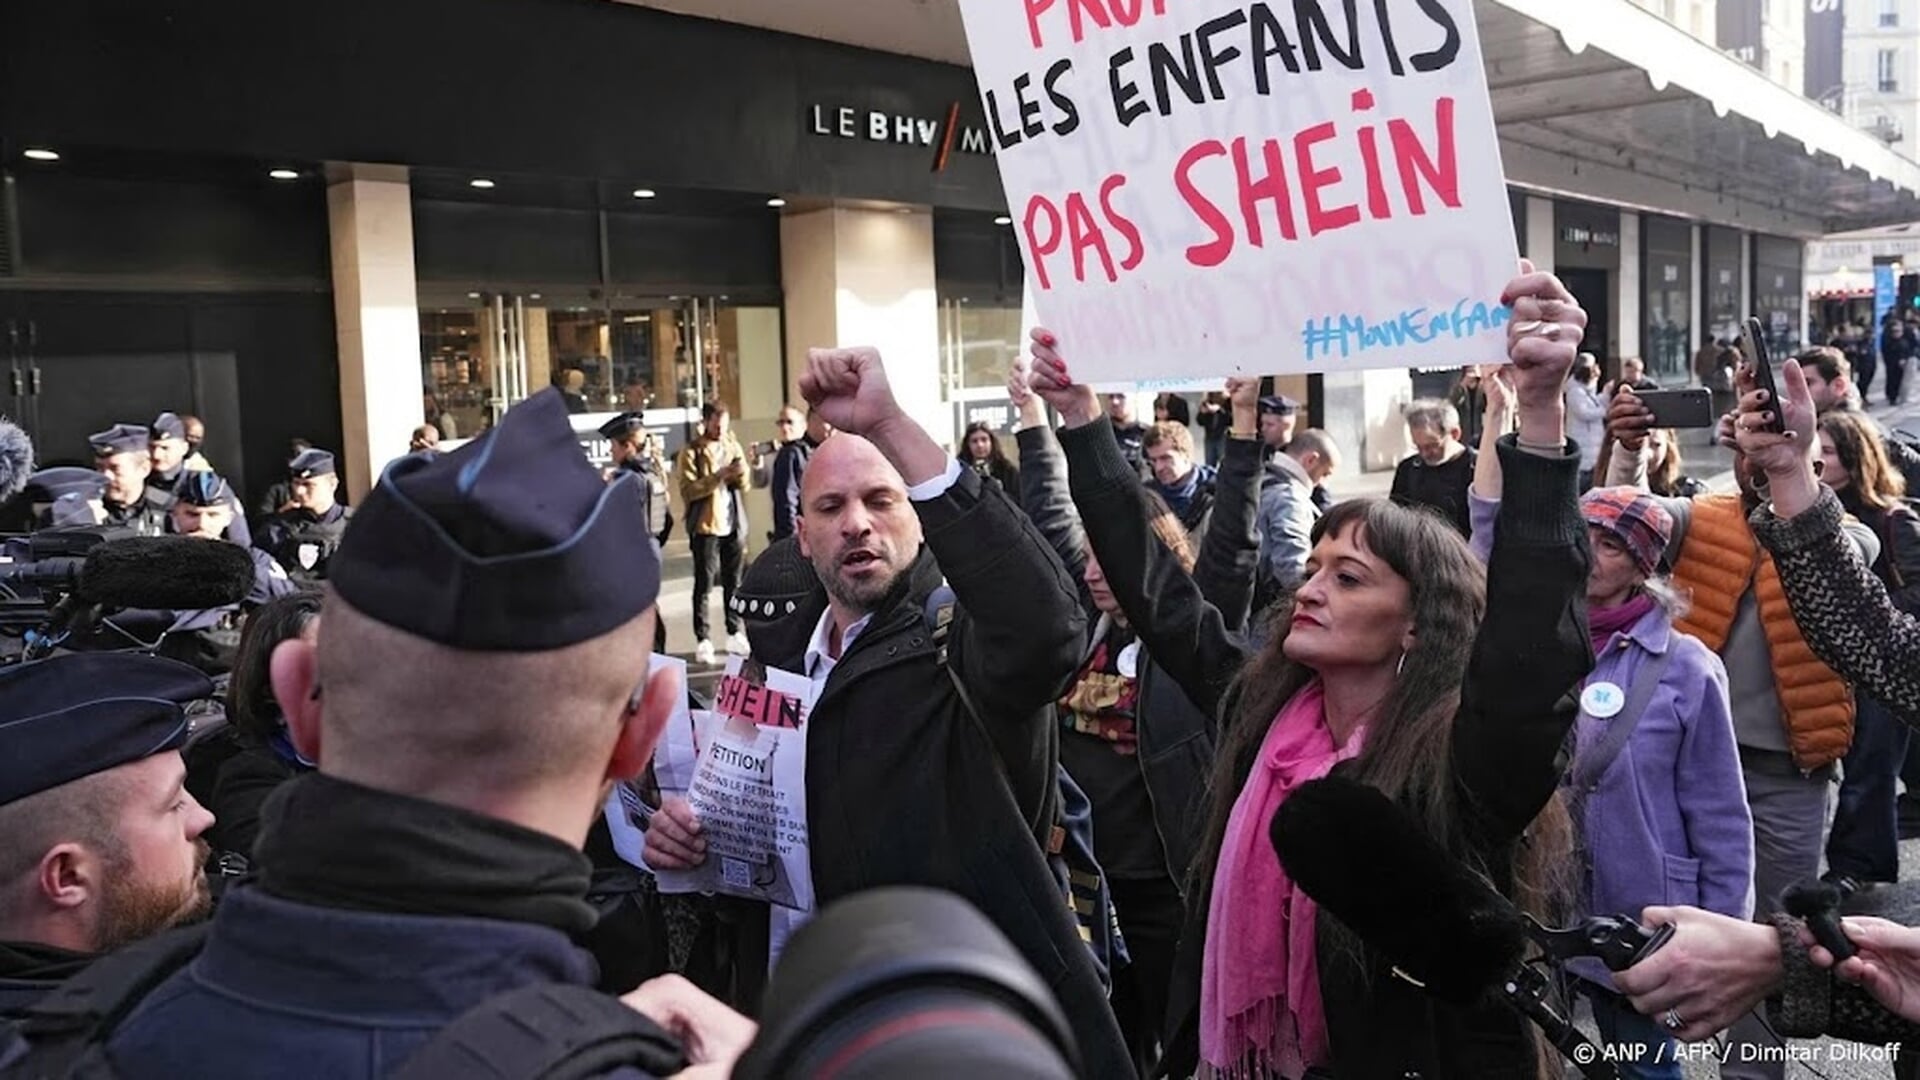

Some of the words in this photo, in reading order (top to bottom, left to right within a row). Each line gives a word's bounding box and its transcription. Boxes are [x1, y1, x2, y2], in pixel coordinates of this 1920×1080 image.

[814, 104, 856, 137] LE
[986, 58, 1081, 151] LES
[1022, 174, 1144, 290] PAS
[717, 674, 802, 731] SHEIN
